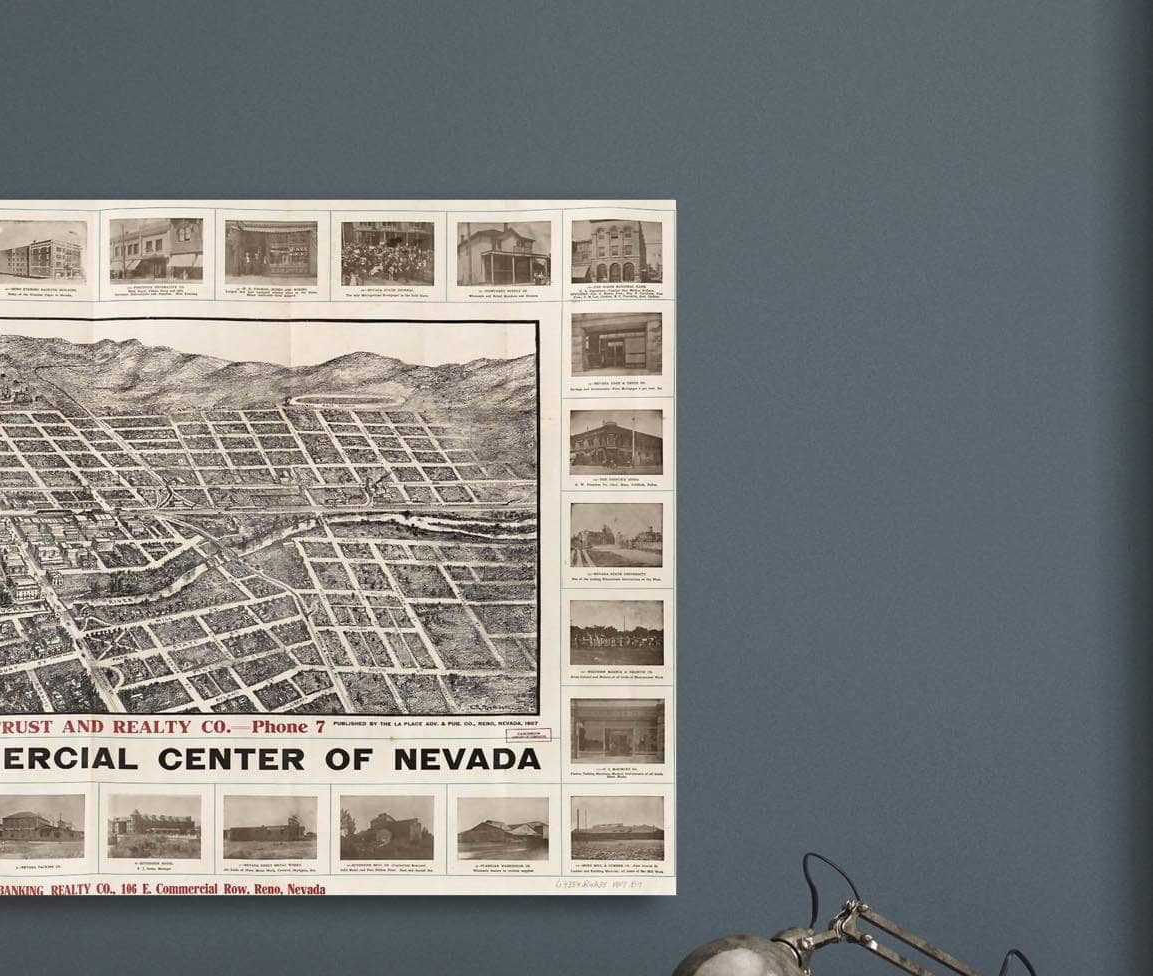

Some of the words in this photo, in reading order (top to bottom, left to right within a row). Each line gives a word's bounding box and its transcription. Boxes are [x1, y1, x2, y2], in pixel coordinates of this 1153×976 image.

[62, 719, 104, 734] AND
[112, 719, 191, 734] REALTY
[315, 719, 325, 734] 7
[158, 746, 305, 771] CENTER
[325, 747, 373, 771] OF
[394, 747, 542, 771] NEVADA
[50, 883, 92, 895] REALTY
[121, 883, 138, 895] 106
[142, 883, 152, 895] E.
[155, 882, 218, 895] Commercial
[287, 883, 326, 895] Nevada
